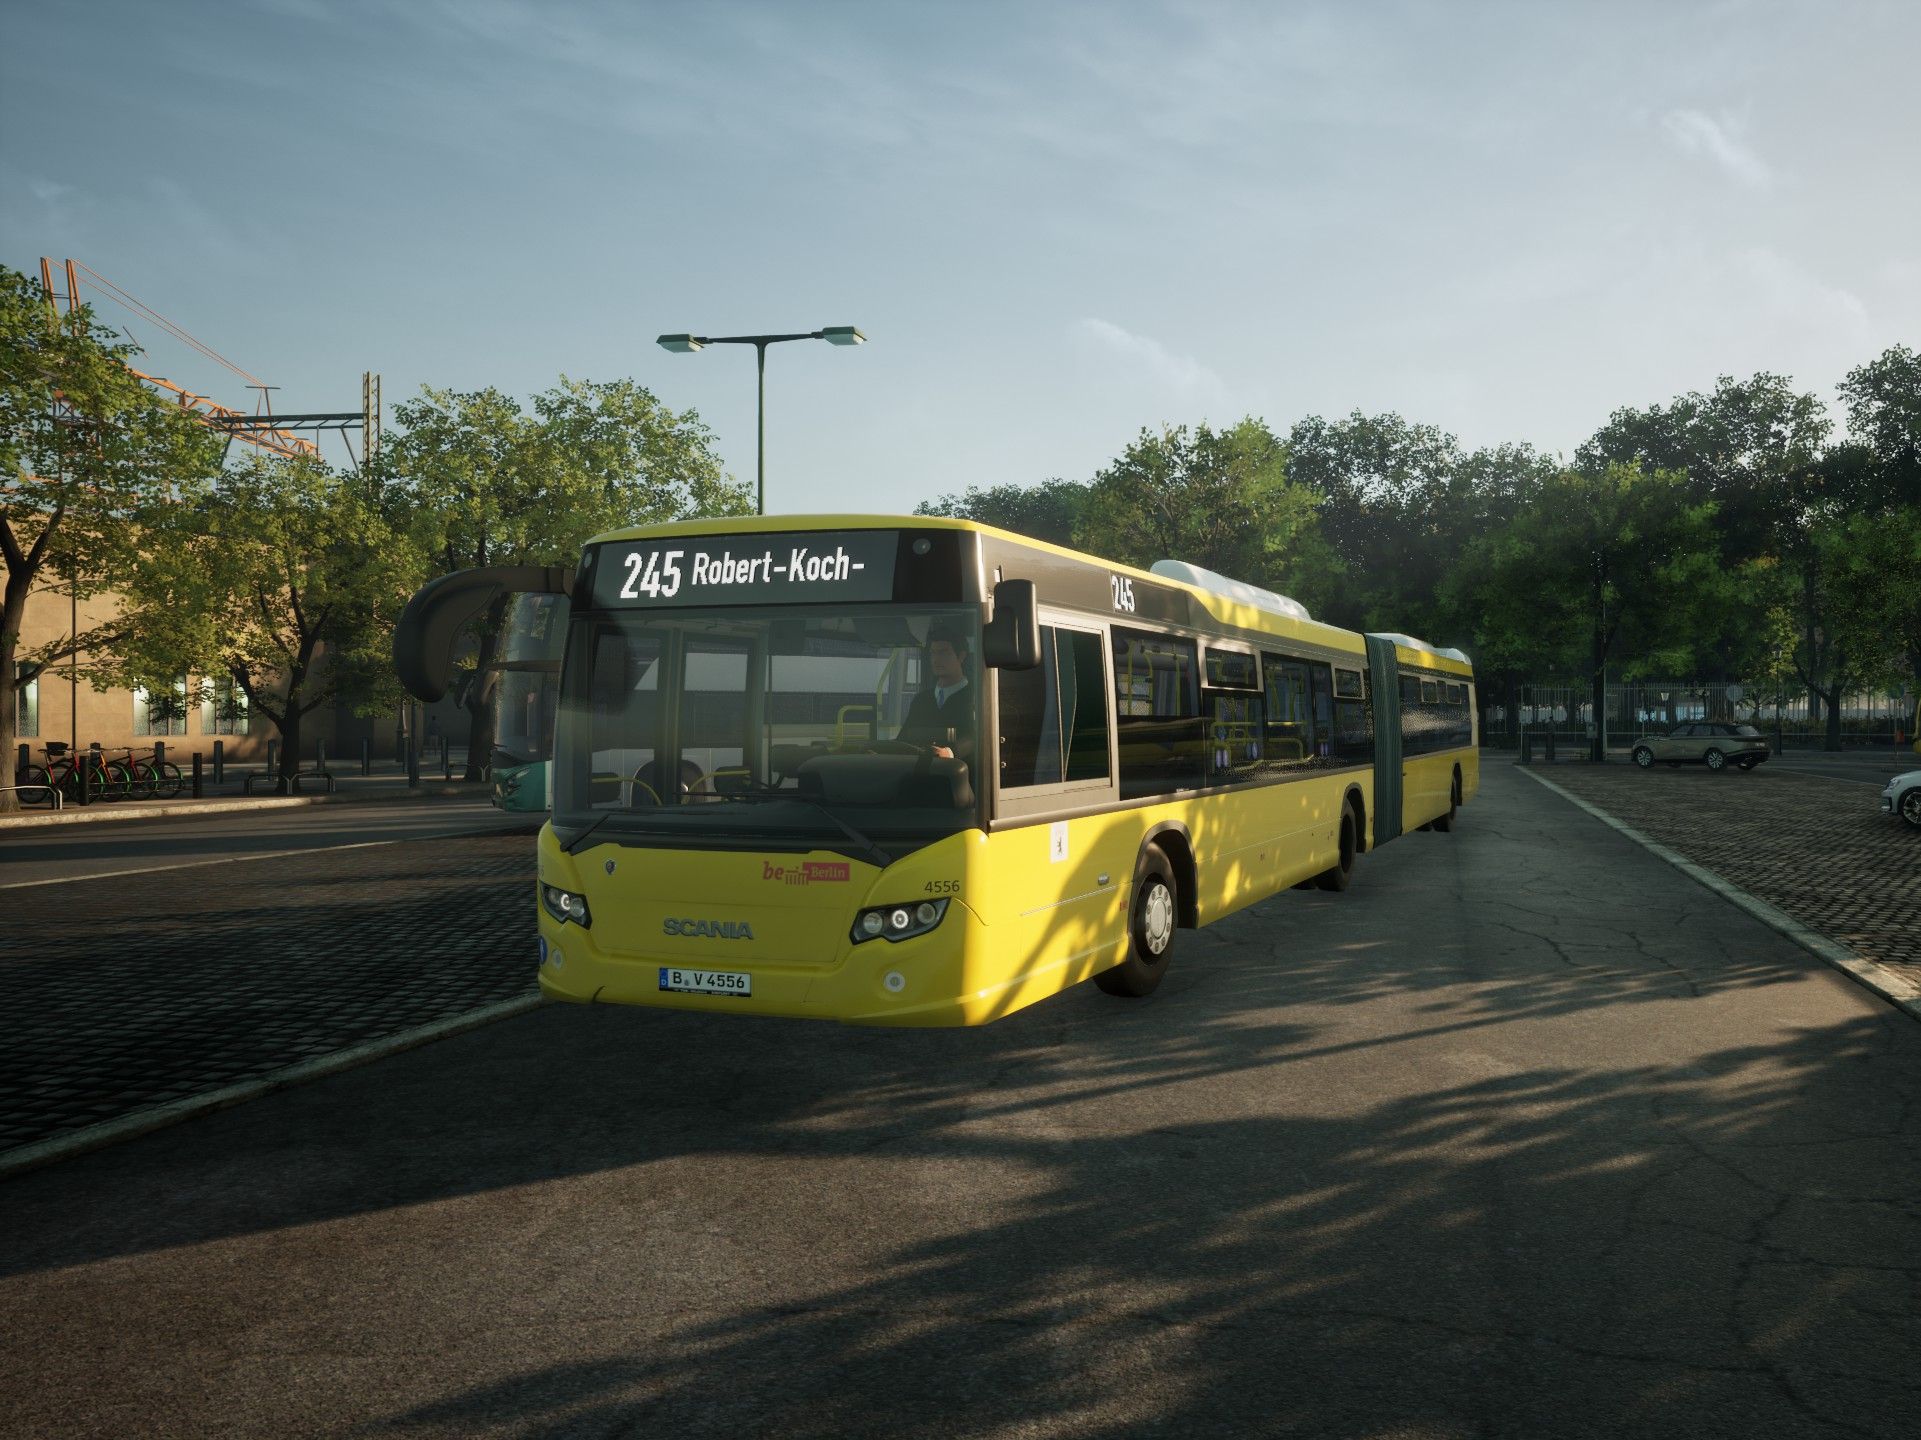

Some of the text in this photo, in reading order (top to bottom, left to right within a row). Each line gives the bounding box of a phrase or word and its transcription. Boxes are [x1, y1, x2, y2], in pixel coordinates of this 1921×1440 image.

[620, 546, 865, 599] 245 Robert-Koch-
[1111, 575, 1136, 612] 245
[810, 866, 846, 879] Berlin
[924, 880, 961, 893] 4556
[663, 918, 754, 940] SCANIA
[673, 971, 682, 984] B
[694, 973, 703, 985] V
[707, 974, 744, 988] 4556
